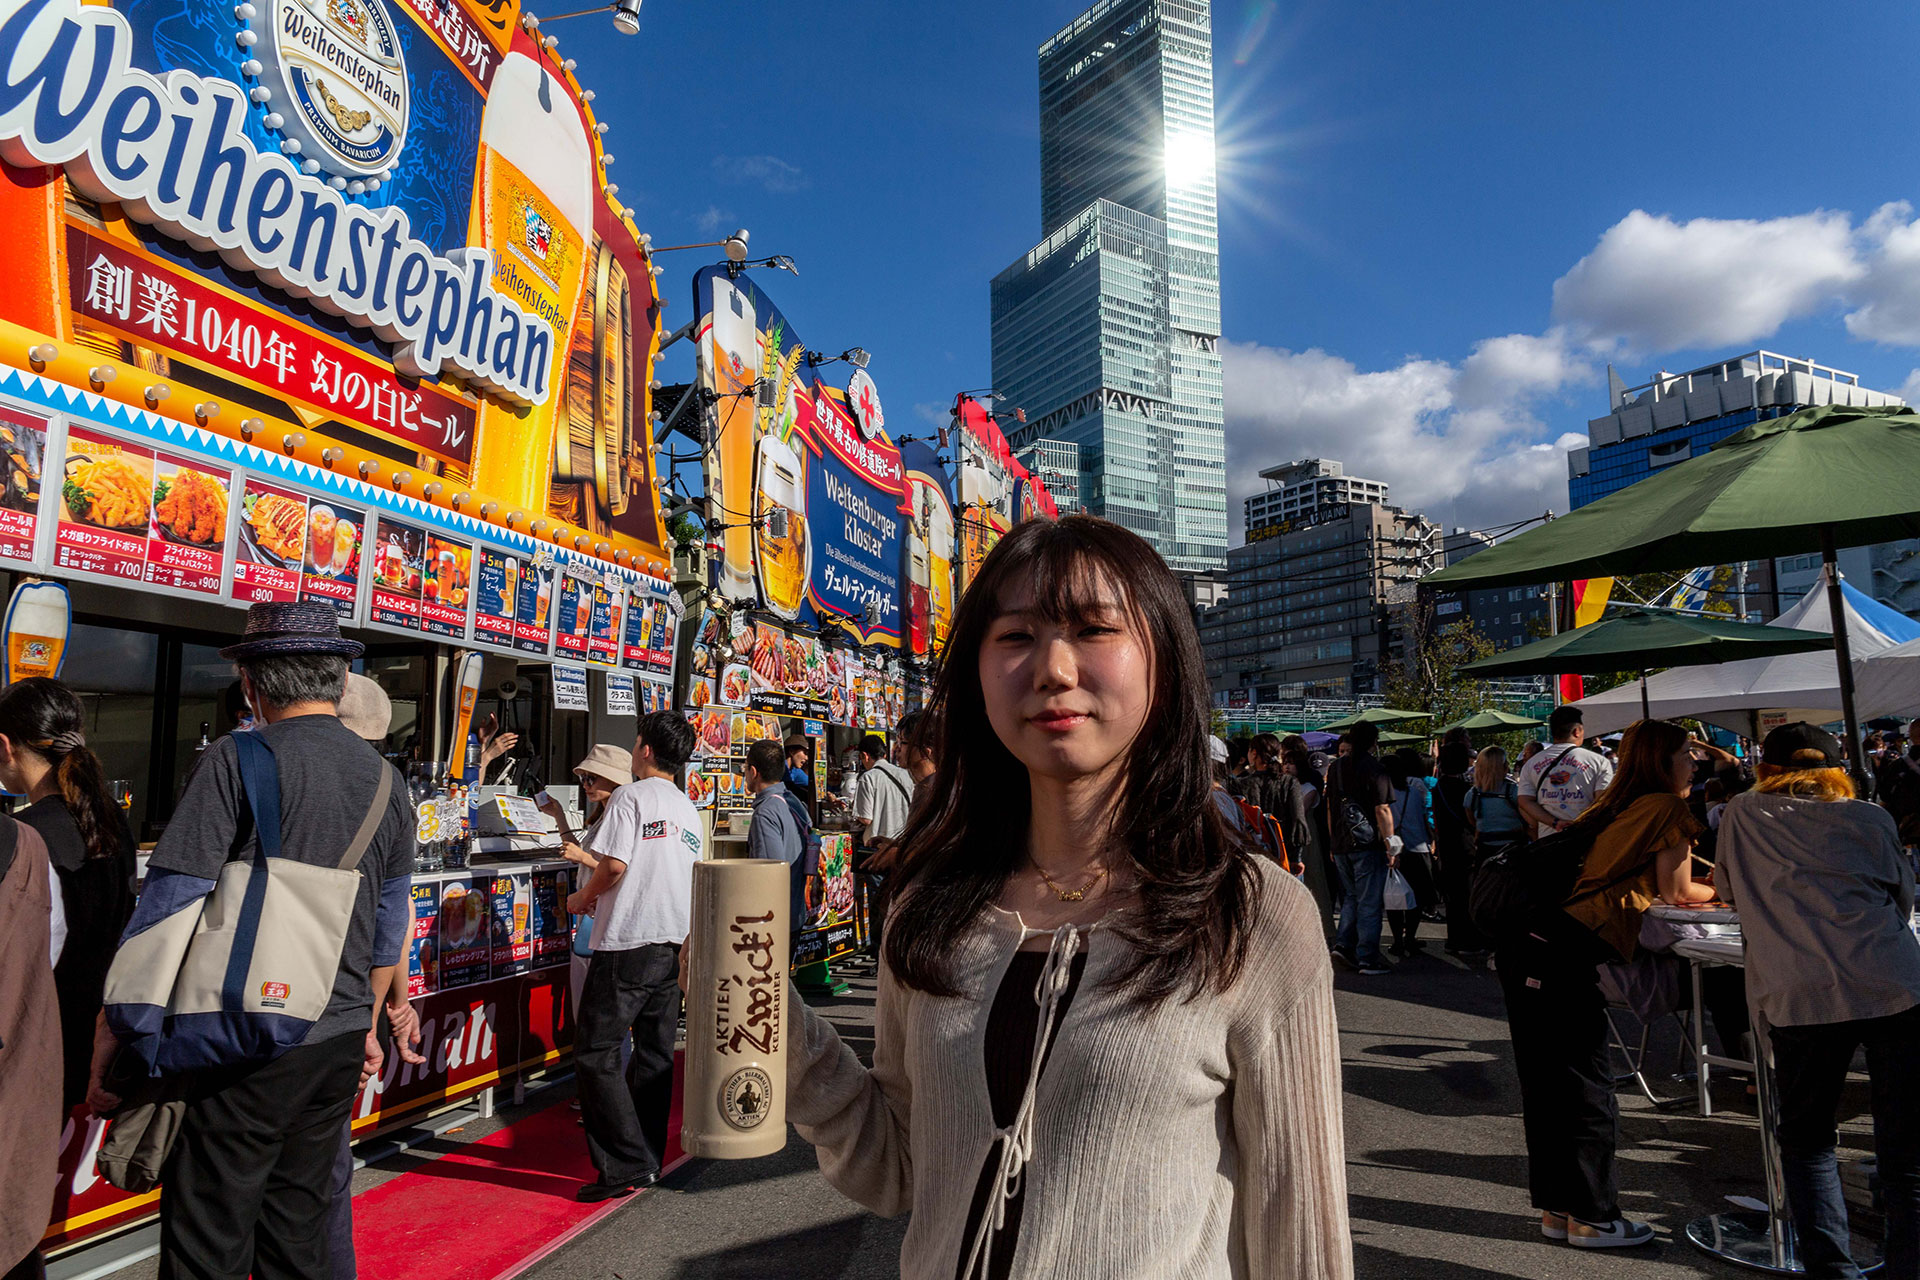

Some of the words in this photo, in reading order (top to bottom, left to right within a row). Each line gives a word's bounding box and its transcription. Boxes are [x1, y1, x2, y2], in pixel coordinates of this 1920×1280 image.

[367, 1, 391, 51] BREWERY
[283, 5, 401, 112] Weihenstephan
[303, 101, 339, 147] PREMIUM
[340, 139, 382, 160] BAVARICUM
[0, 8, 548, 396] Weihenstephan
[491, 249, 569, 336] Weihenstephan
[84, 252, 298, 385] 創業1040年
[310, 350, 466, 449] 幻の白ビール
[815, 397, 902, 483] 世界最古の修道院ビール
[823, 468, 897, 541] Weltenburger
[1334, 504, 1347, 519] INN
[844, 511, 883, 560] Kloster
[114, 560, 141, 577] ¥700
[199, 575, 220, 591] ¥900
[824, 563, 899, 616] ヴェルテンブルガー
[251, 588, 273, 603] ¥900
[1560, 788, 1585, 801] York
[643, 820, 666, 831] HOT
[644, 828, 664, 838] 97
[715, 976, 733, 1057] AKTIEN
[772, 970, 782, 1054] KELLERBIER
[737, 1114, 760, 1122] AKTIEN
